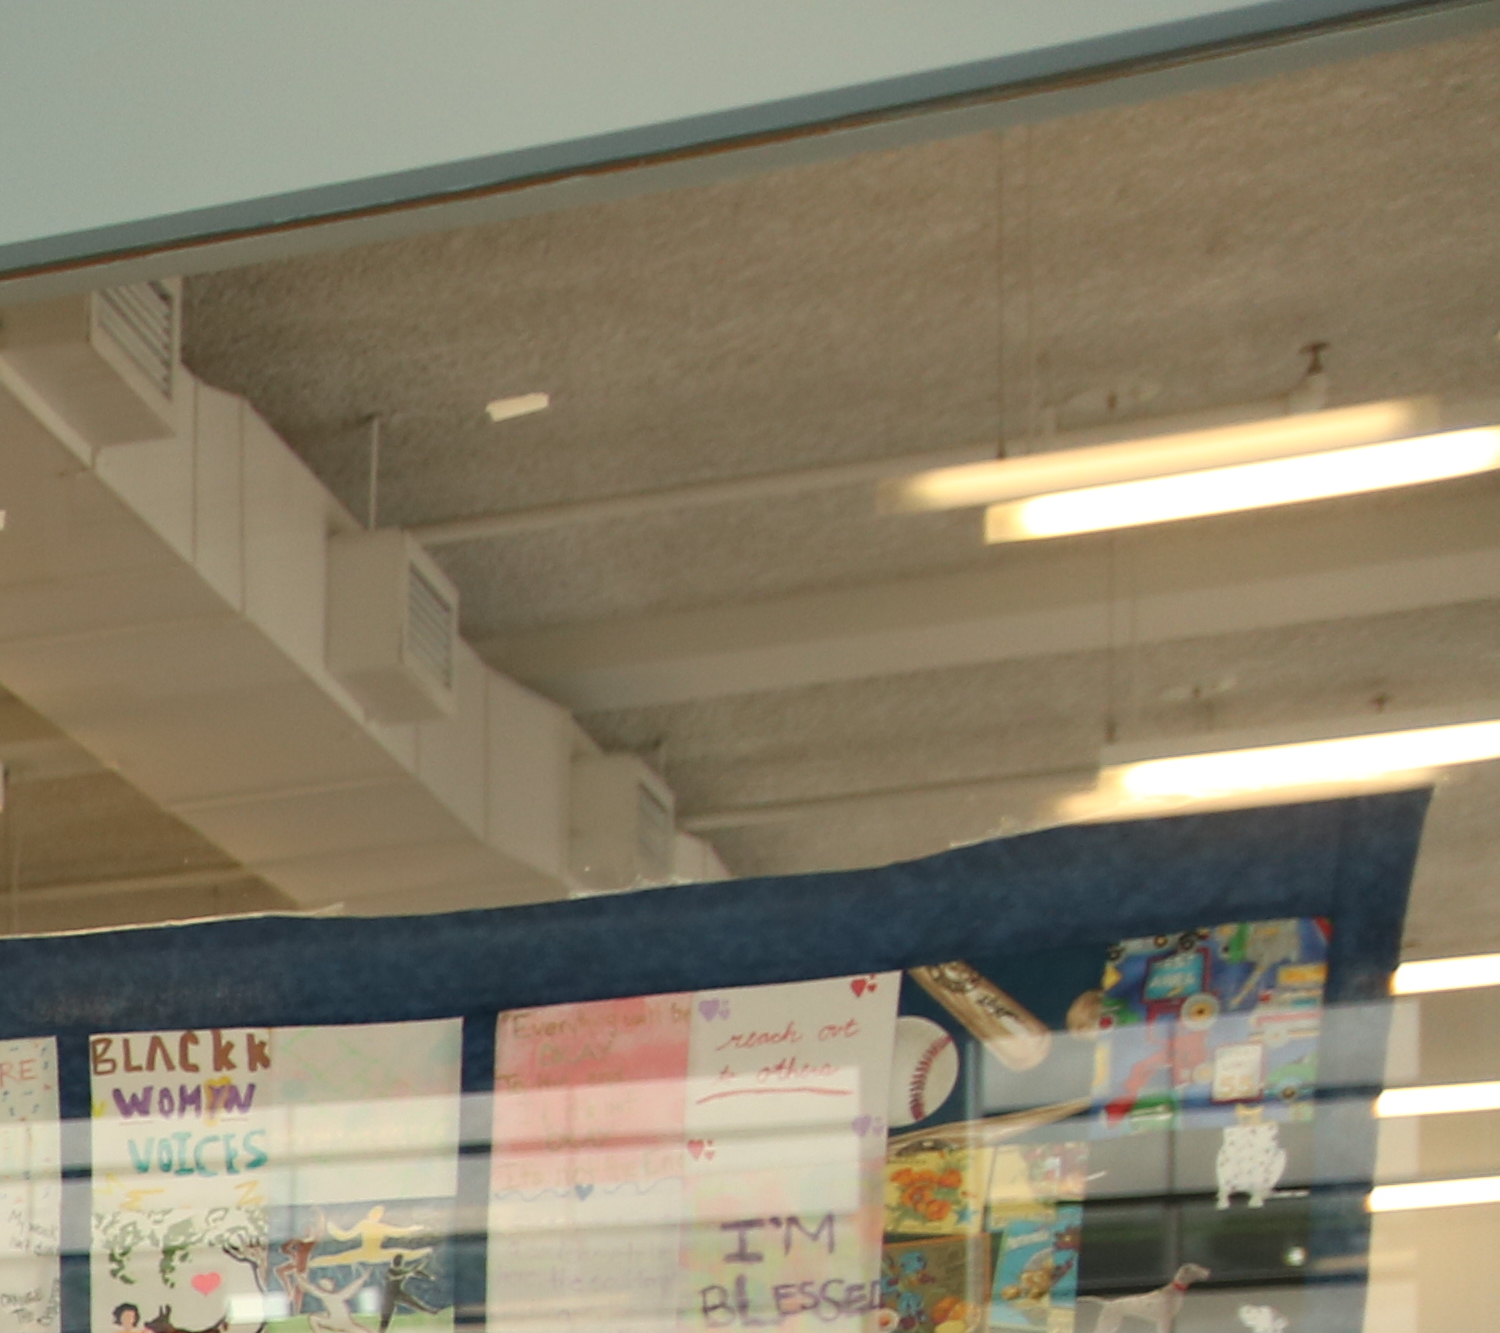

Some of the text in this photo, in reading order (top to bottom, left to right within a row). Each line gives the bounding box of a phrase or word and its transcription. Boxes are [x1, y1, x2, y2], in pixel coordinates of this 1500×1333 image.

[717, 1021, 802, 1050] reach
[128, 1129, 268, 1177] VOICES
[720, 1212, 835, 1263] I'M
